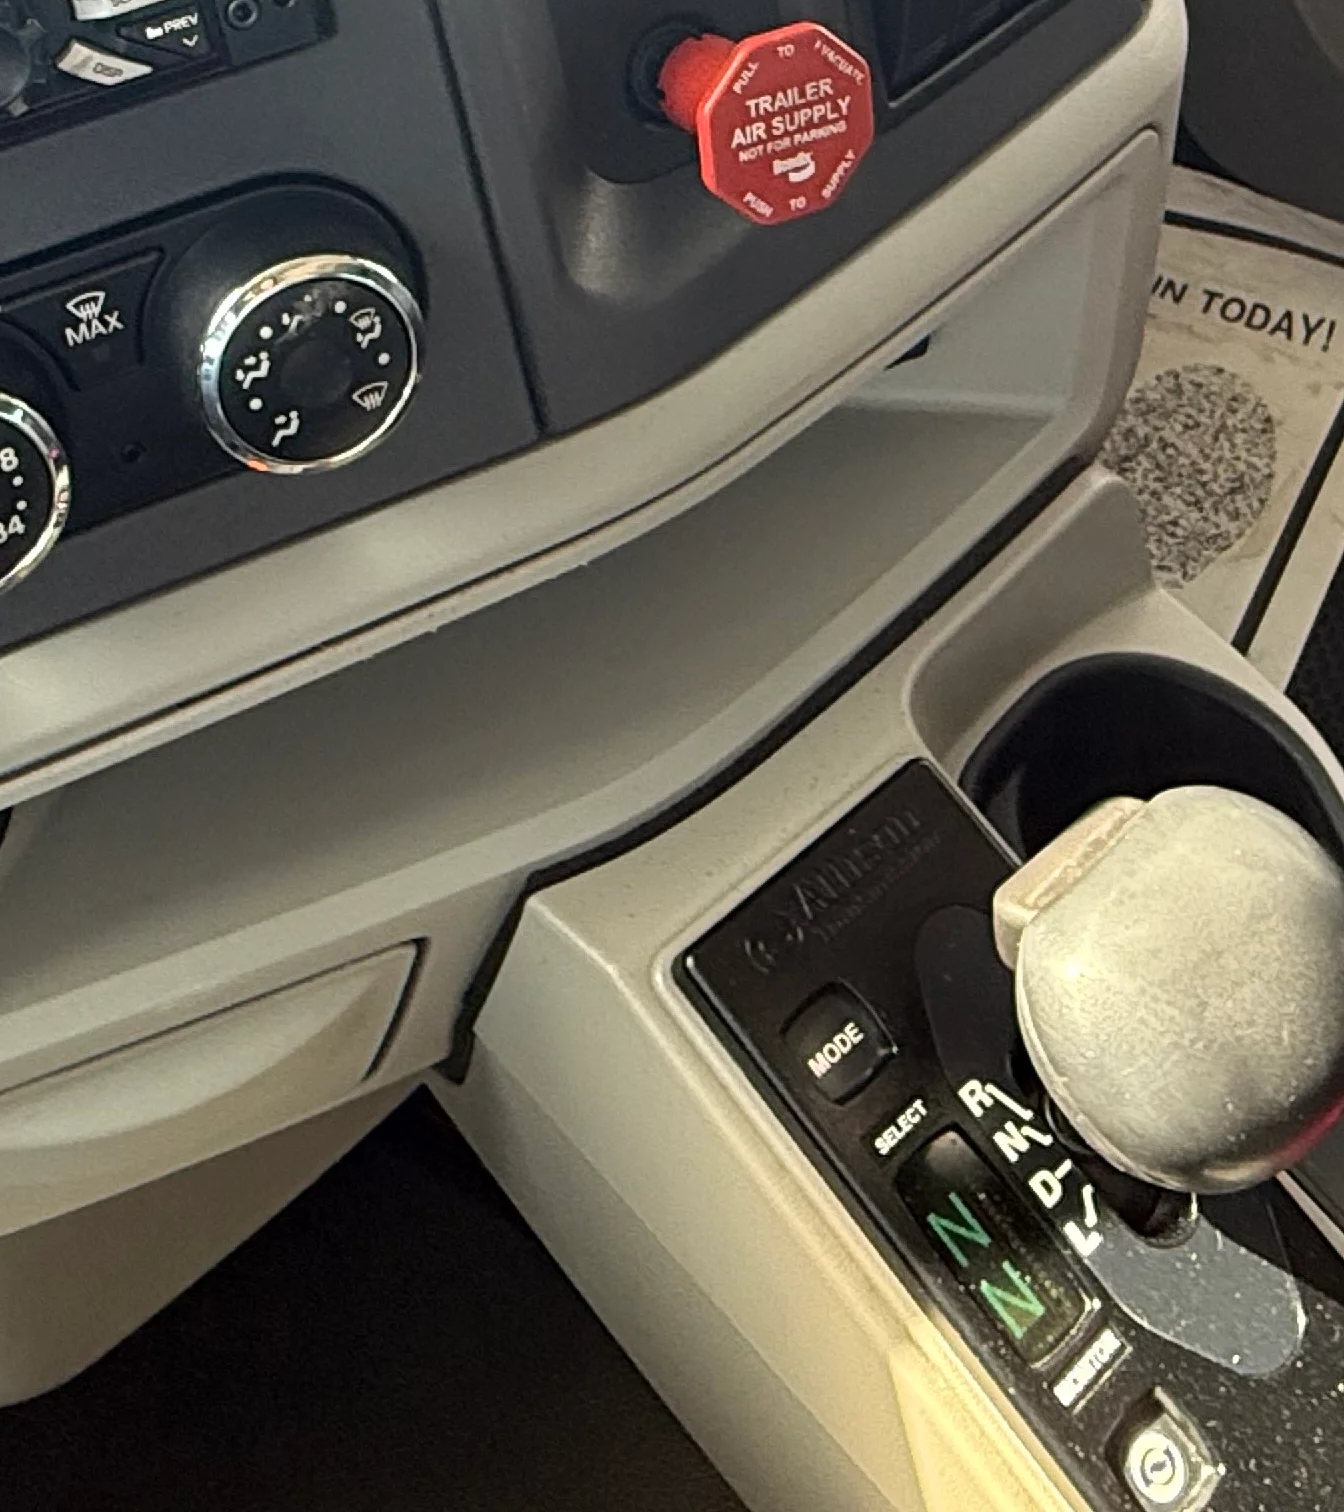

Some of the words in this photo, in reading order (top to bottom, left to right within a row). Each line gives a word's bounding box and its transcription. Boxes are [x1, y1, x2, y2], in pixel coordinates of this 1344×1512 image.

[163, 12, 199, 34] PREV
[776, 44, 795, 59] TO
[745, 78, 834, 118] TRAILER
[731, 121, 768, 149] AIR
[771, 94, 852, 136] SUPPLY
[738, 143, 764, 162] NOT
[766, 136, 792, 154] FOR
[793, 120, 847, 147] PARKING
[788, 195, 806, 212] TO
[64, 310, 125, 348] MAX
[1201, 288, 1338, 354] TODAY!
[806, 1021, 866, 1081] MODE
[958, 1078, 993, 1118] R
[873, 1098, 929, 1157] SELECT
[993, 1121, 1030, 1163] N
[1029, 1171, 1063, 1209] D
[927, 1191, 993, 1268] N
[979, 1259, 1045, 1340] N
